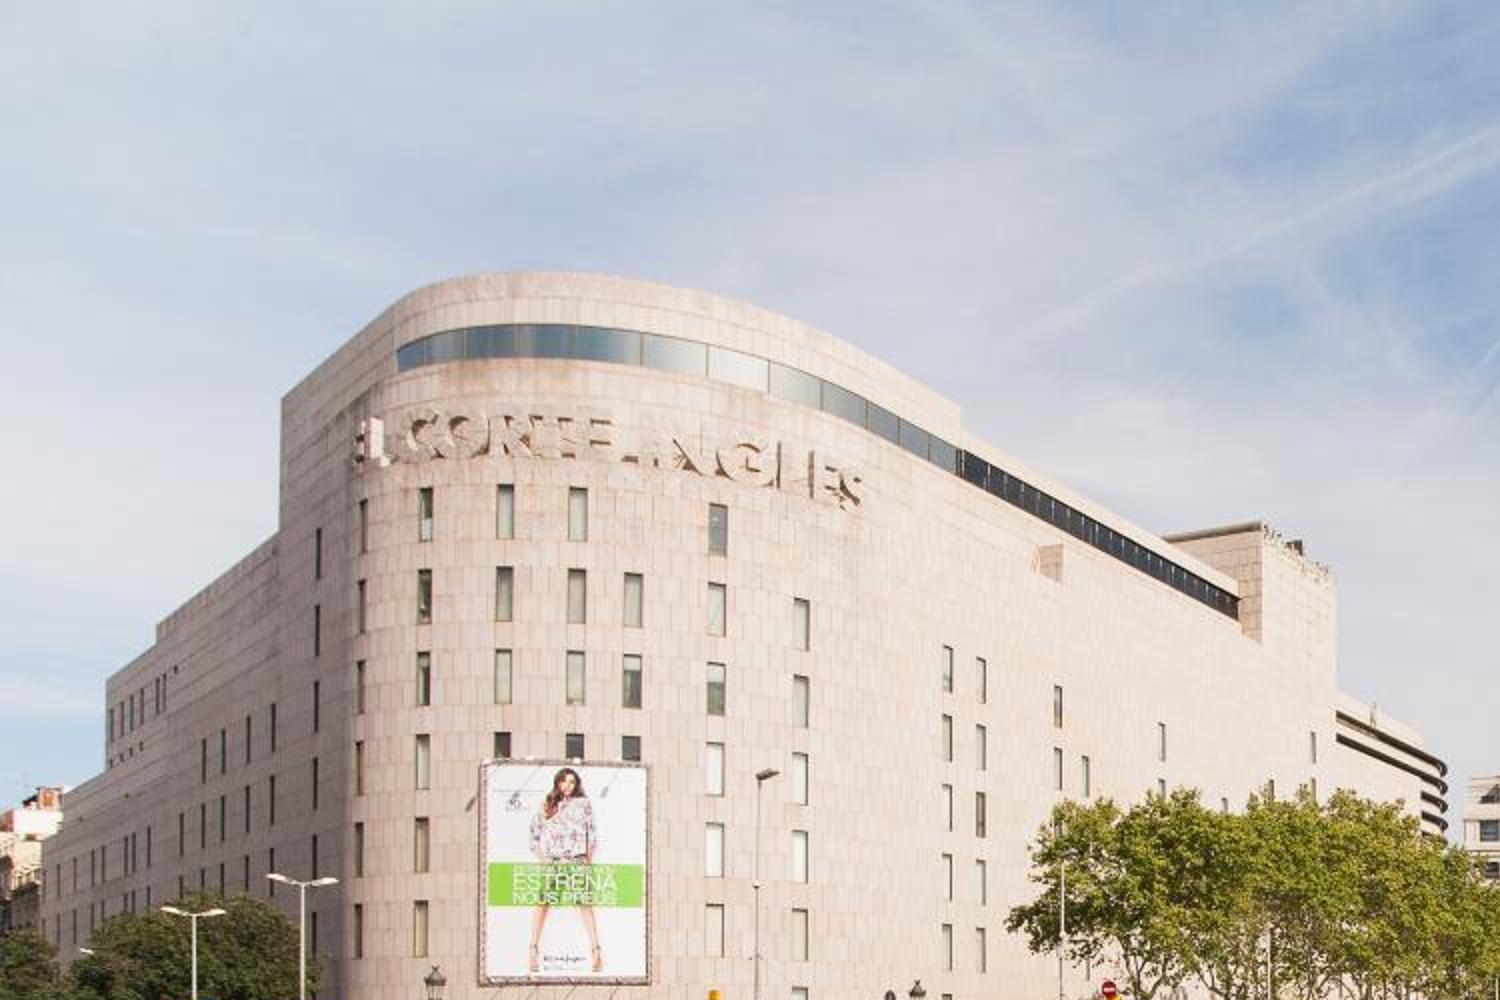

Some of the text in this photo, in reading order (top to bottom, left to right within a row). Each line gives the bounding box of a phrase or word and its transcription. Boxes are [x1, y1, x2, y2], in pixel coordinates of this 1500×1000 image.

[404, 407, 618, 463] CORTE
[513, 873, 617, 891] ESTRENA
[513, 891, 559, 905] NOUS
